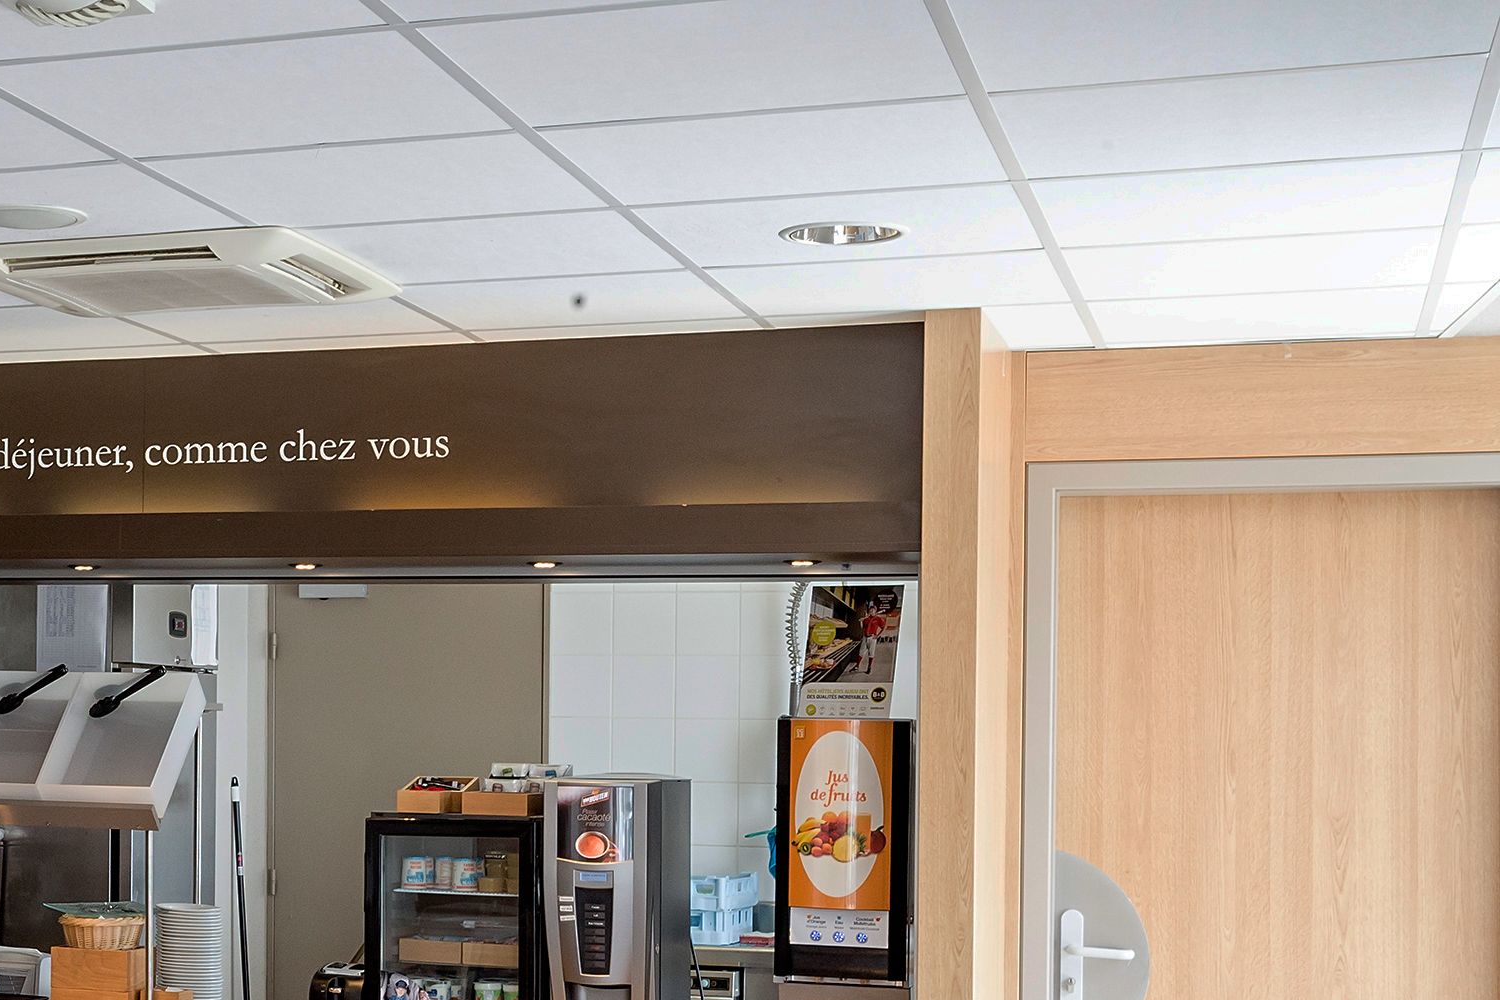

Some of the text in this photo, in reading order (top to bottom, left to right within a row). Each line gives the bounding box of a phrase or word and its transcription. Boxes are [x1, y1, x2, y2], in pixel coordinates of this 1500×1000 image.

[144, 441, 268, 466] comme
[279, 429, 356, 461] chez
[367, 435, 450, 460] vous
[825, 770, 849, 785] Jus
[810, 783, 867, 807] de fruts
